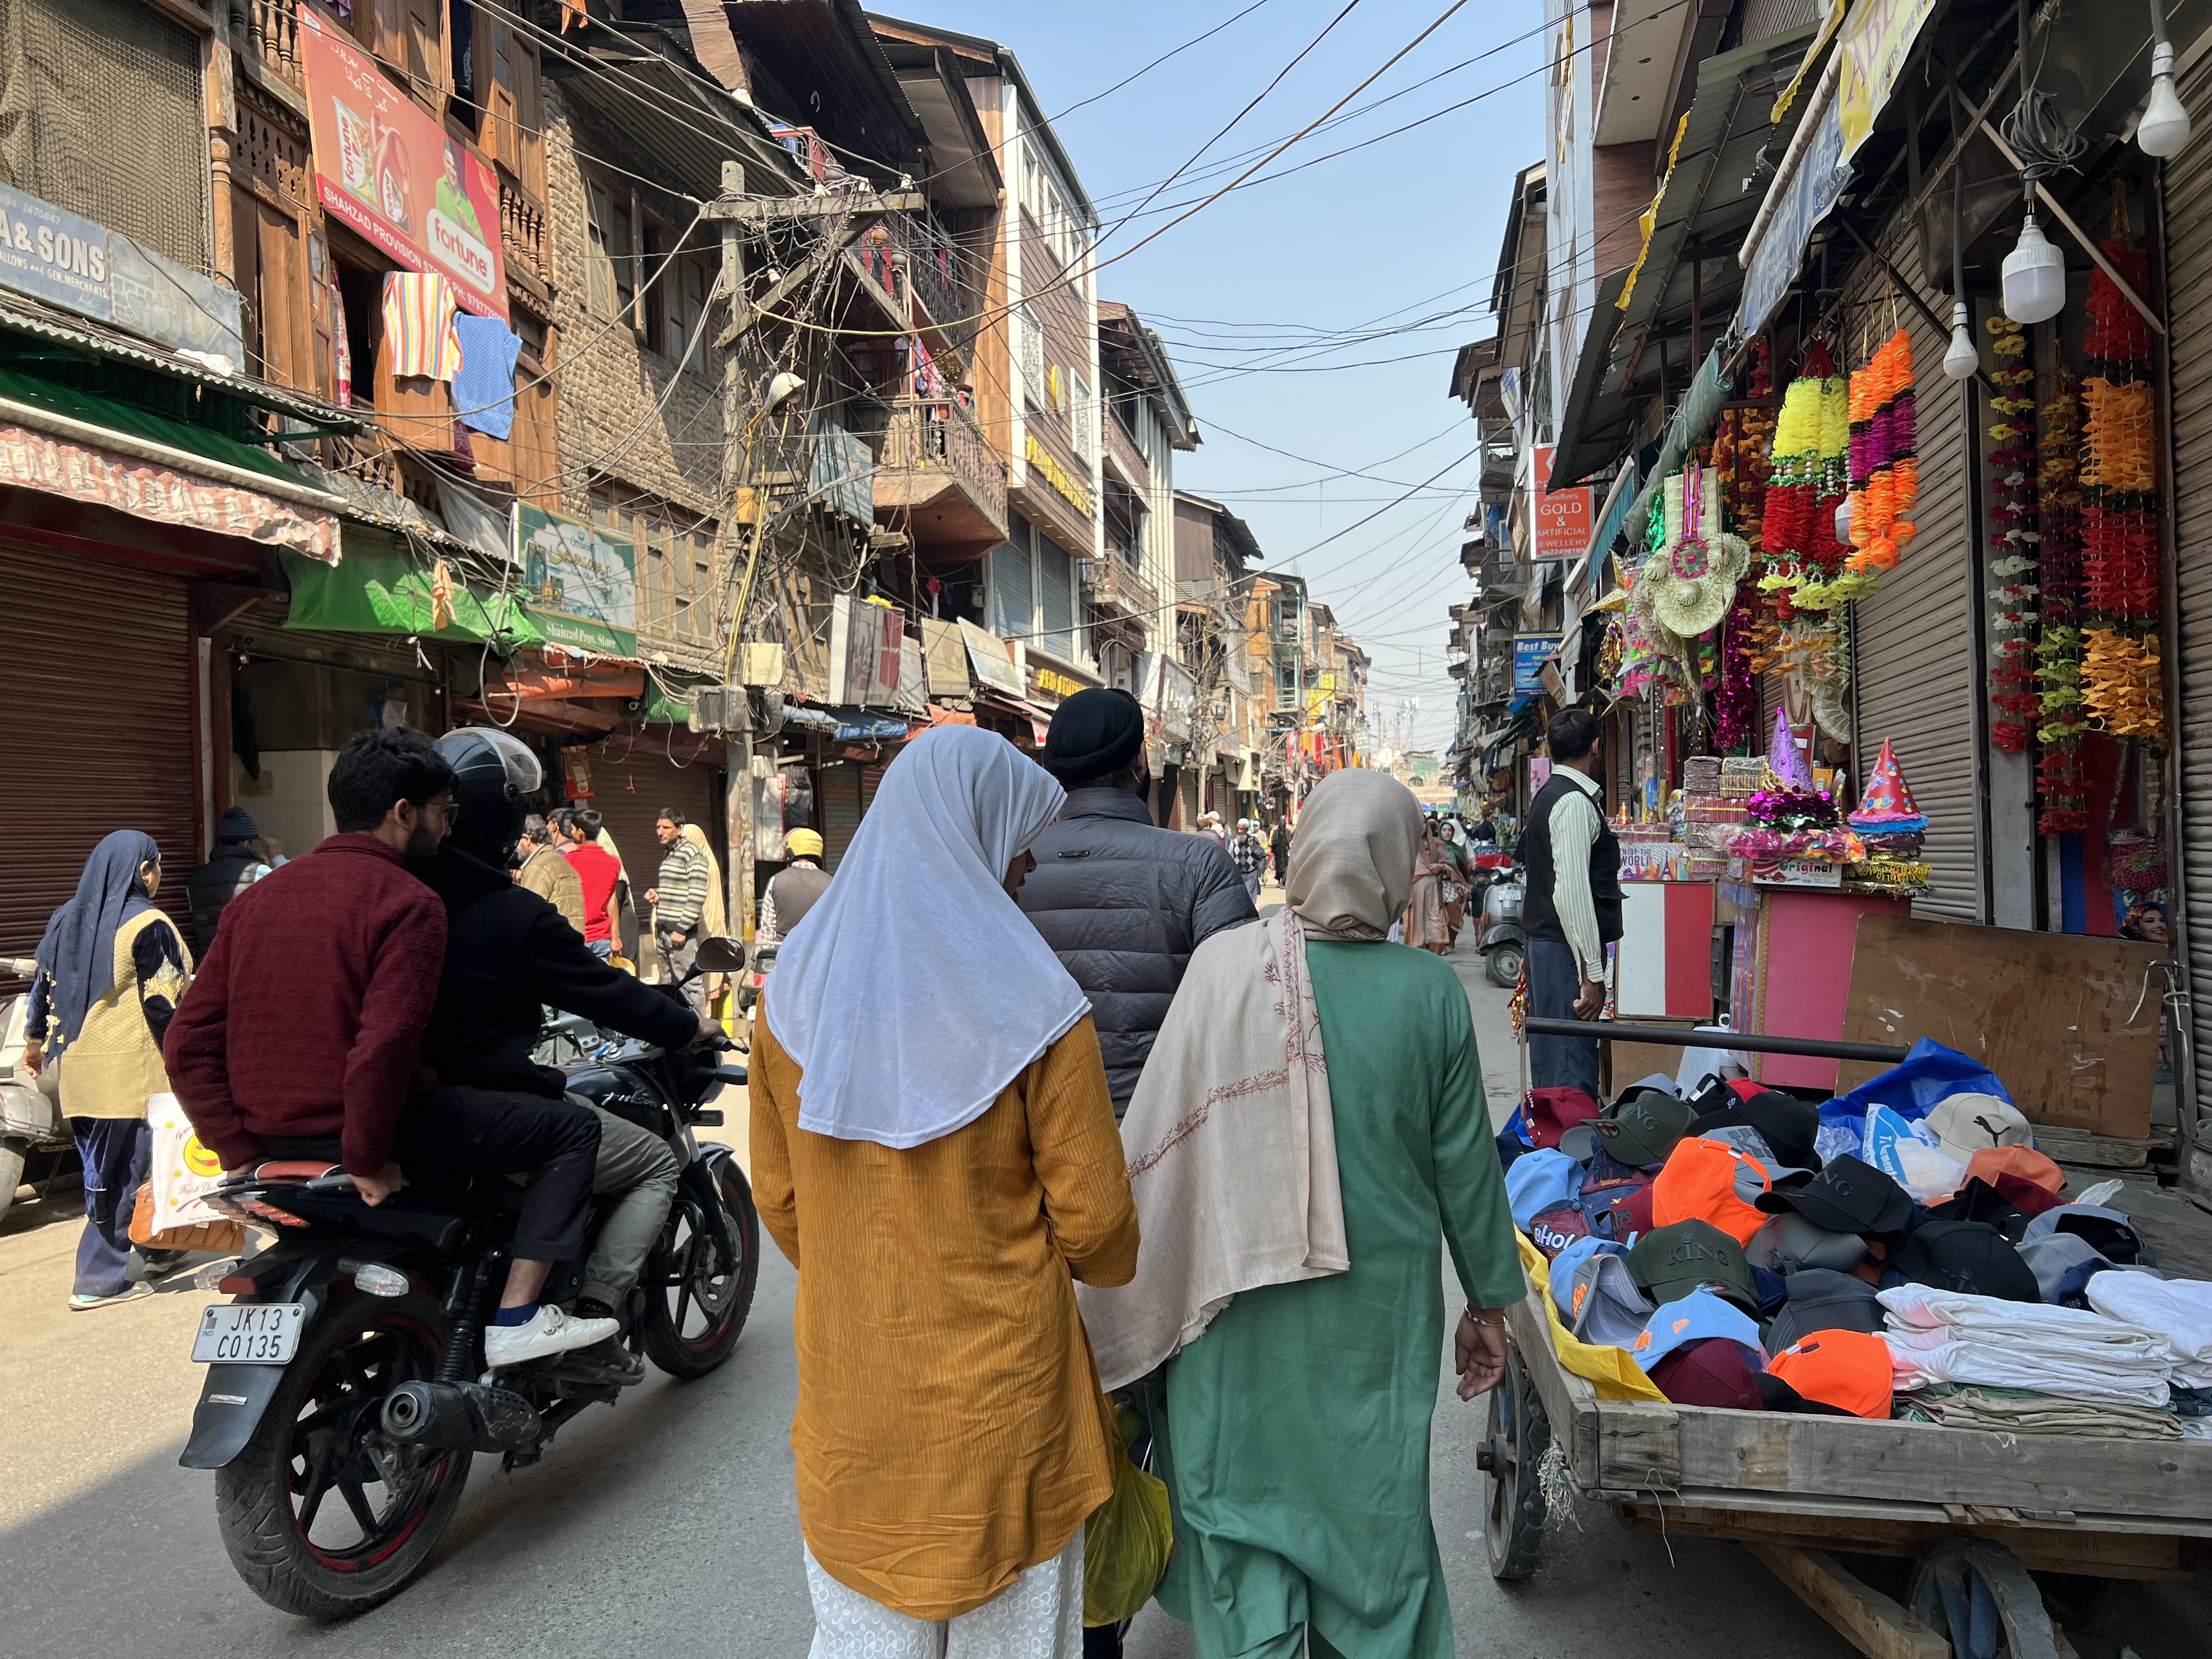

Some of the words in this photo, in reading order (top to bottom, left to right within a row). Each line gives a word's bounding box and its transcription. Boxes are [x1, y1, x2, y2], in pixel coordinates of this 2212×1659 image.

[1900, 9, 1916, 48] FIRE
[1829, 174, 1837, 189] &
[22, 203, 61, 225] 2470647
[324, 186, 371, 231] SHAHZAD
[373, 222, 422, 269] PROVISION
[14, 222, 36, 255] &
[38, 225, 106, 283] SONS
[435, 217, 488, 277] fortune
[1541, 502, 1582, 516] GOLD
[1556, 516, 1566, 527] &
[1536, 527, 1588, 537] ARTIFICIAL
[1537, 538, 1588, 549] JEWELLERY
[598, 633, 616, 649] Store
[1517, 641, 1538, 651] Best
[1620, 856, 1652, 867] WORLD
[1779, 861, 1833, 874] Original
[179, 1183, 200, 1195] Thank
[1666, 1243, 1729, 1266] KING
